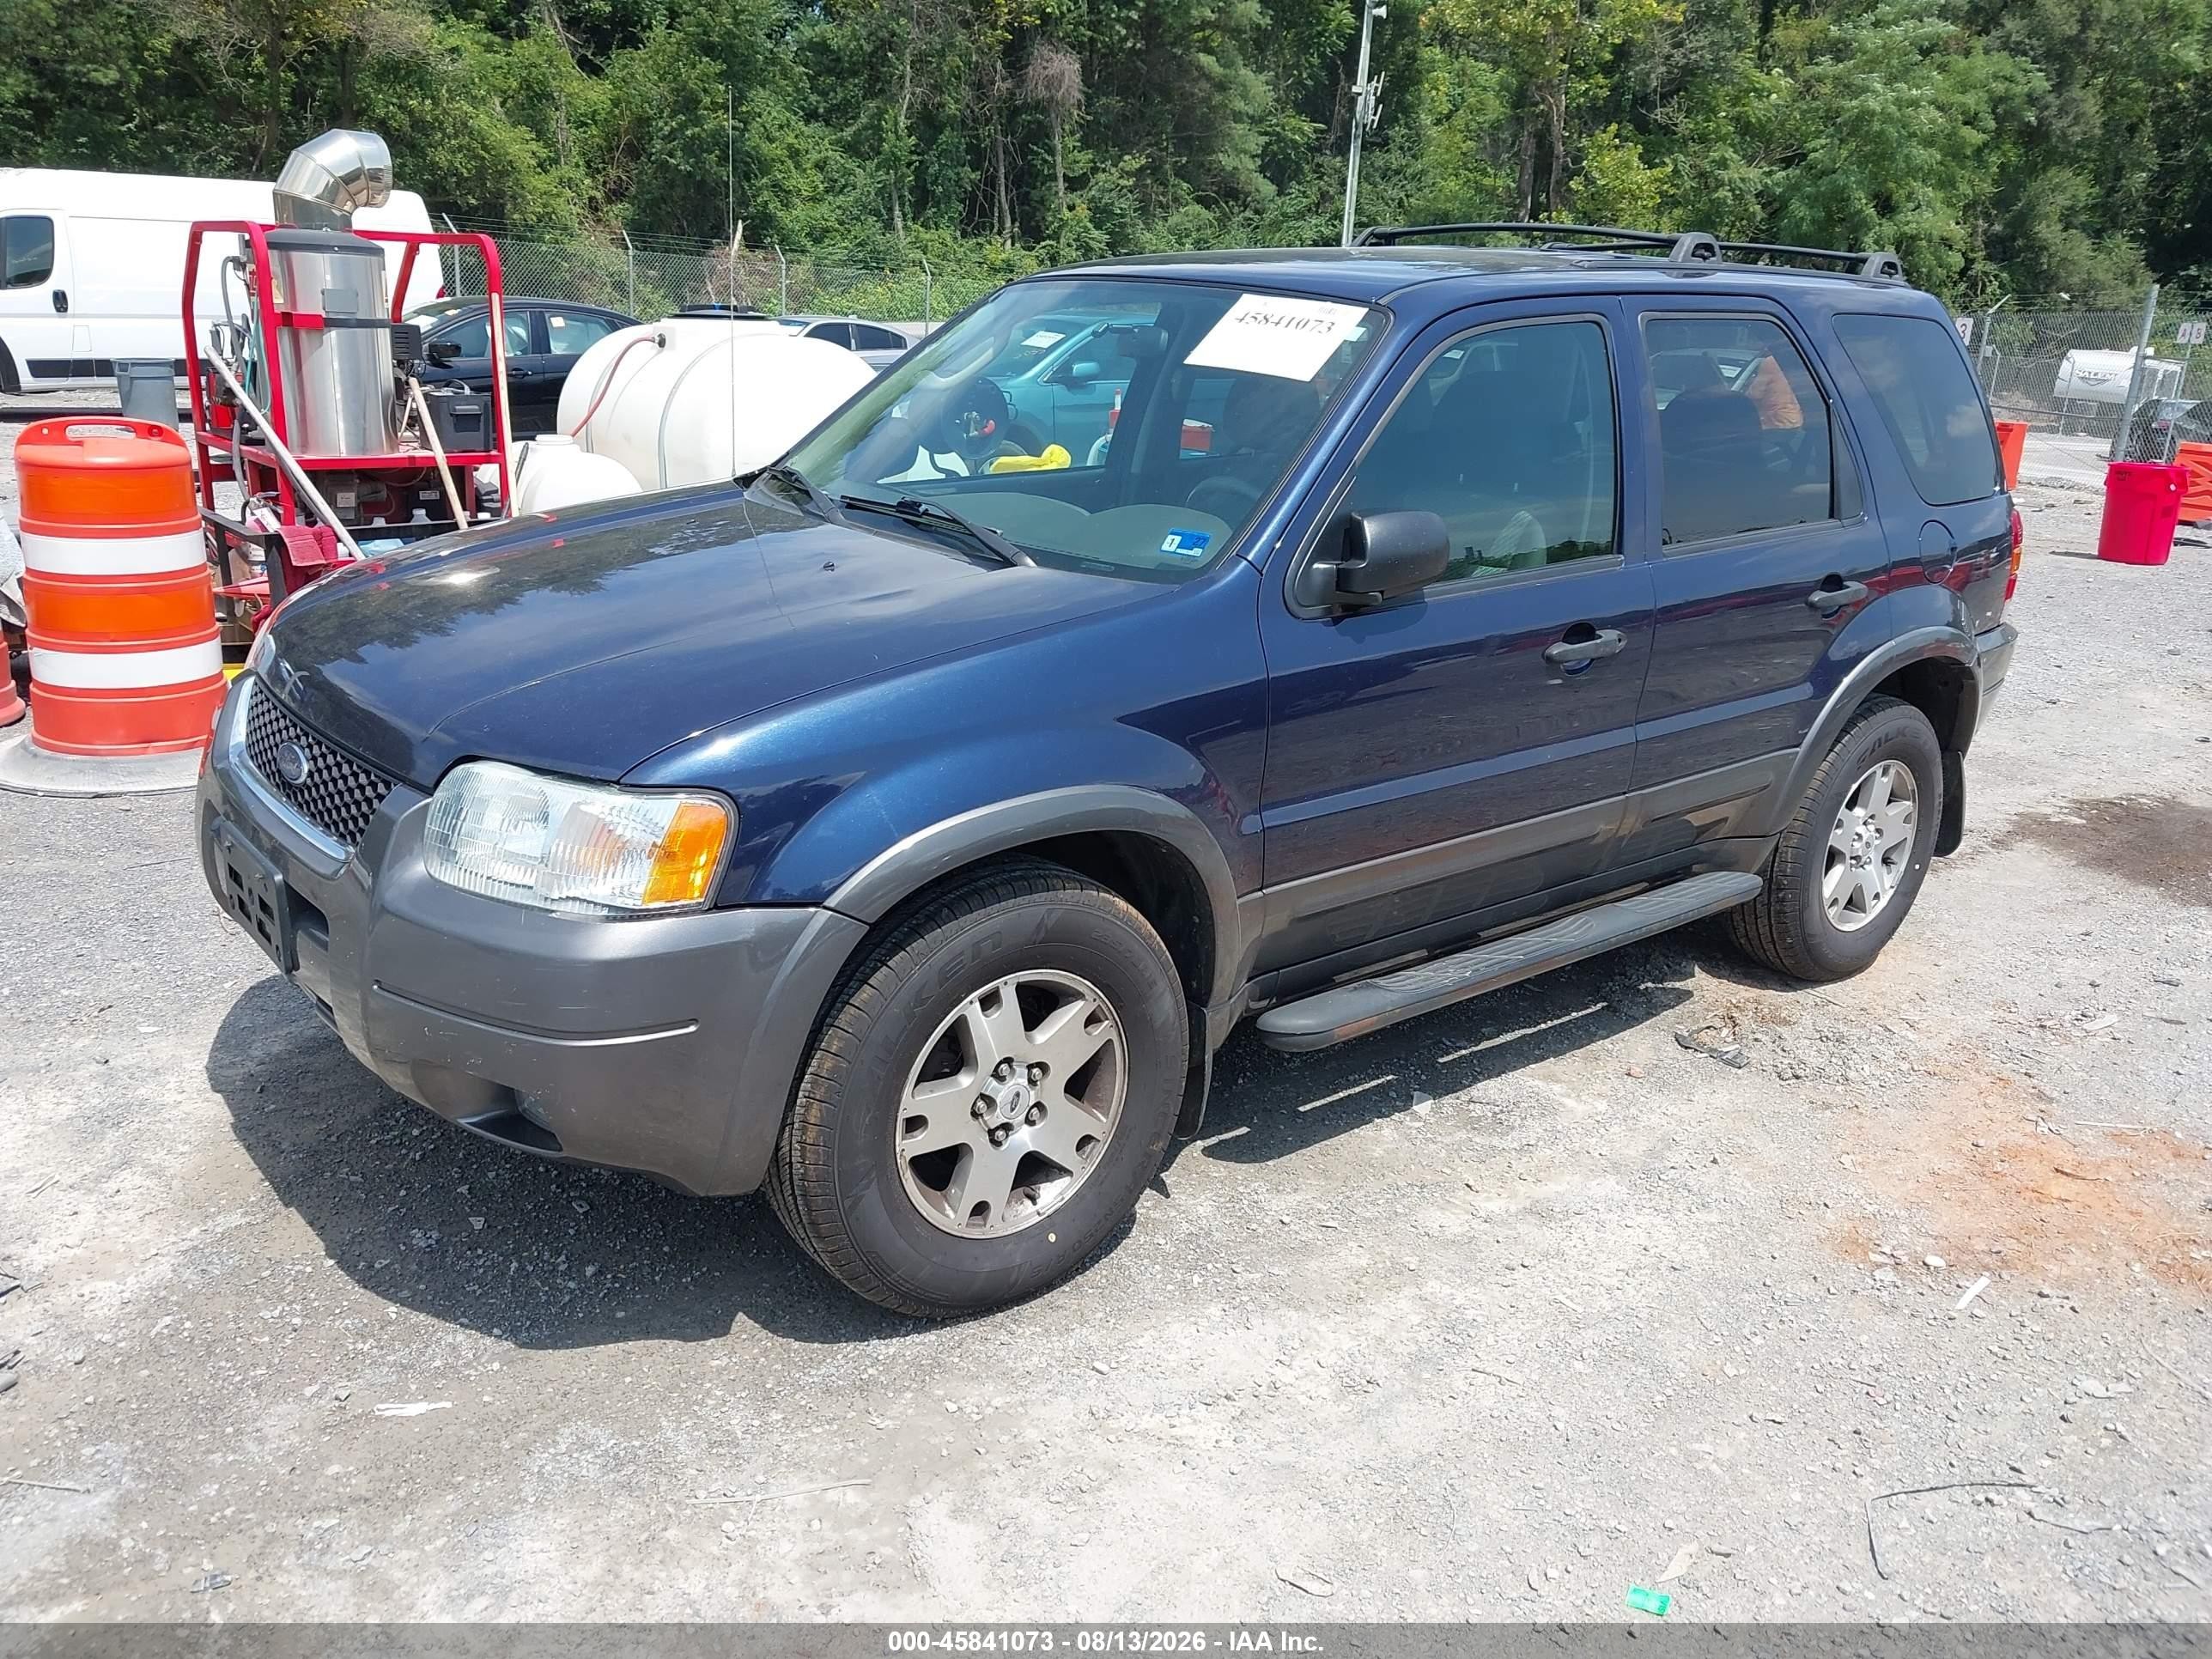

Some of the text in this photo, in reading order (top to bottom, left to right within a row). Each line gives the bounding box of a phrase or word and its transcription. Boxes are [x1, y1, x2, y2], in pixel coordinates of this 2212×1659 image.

[1234, 310, 1336, 334] 45841073
[1960, 323, 1967, 340] 3
[1193, 537, 1207, 547] 27
